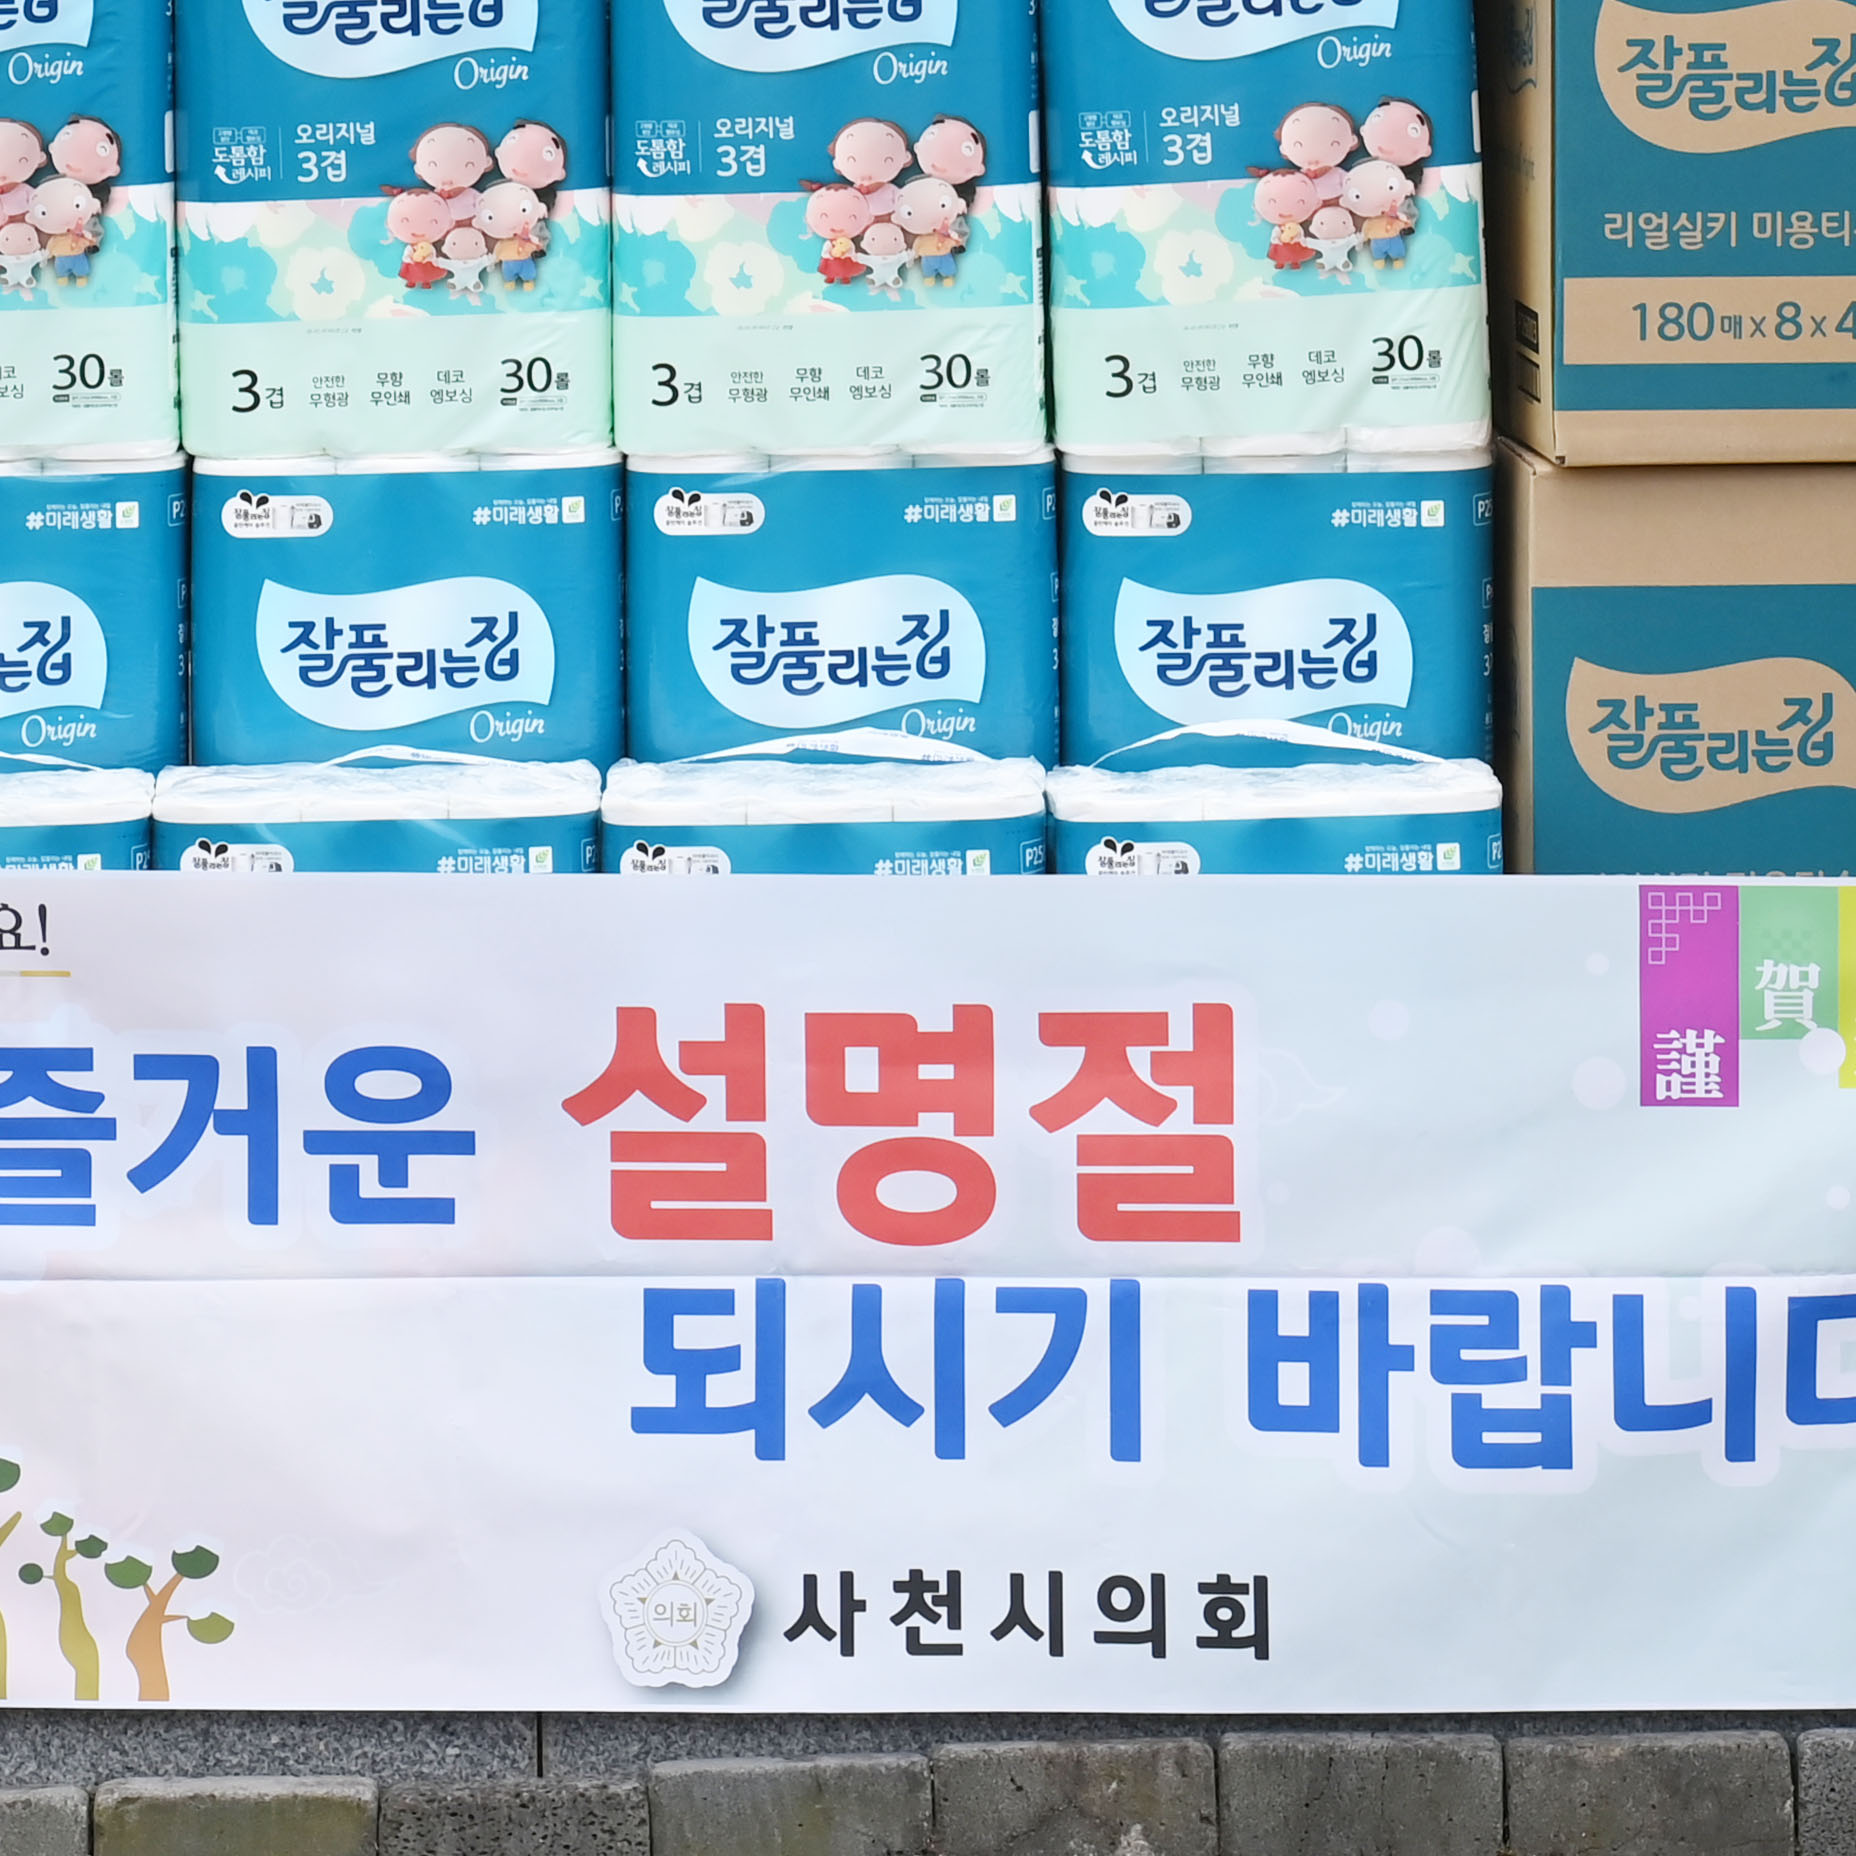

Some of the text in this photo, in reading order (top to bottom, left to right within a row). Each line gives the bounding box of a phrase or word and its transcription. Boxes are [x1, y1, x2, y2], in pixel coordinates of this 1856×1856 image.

[1318, 35, 1391, 70] Origin
[9, 51, 84, 87] Origin
[455, 56, 530, 92] Origin
[874, 51, 949, 87] Origin
[1160, 104, 1240, 128] 오리지널
[294, 121, 376, 146] 오리지널
[713, 115, 795, 140] 오리지널
[634, 139, 685, 159] 도톰함
[1079, 130, 1132, 151] 도톰함
[1162, 132, 1212, 165] 3겹
[213, 145, 266, 166] 도톰함
[297, 149, 347, 182] 3겹
[715, 143, 766, 176] 3겹
[1603, 211, 1738, 250] 리얼실키
[1183, 358, 1215, 372] 안전한
[1247, 352, 1274, 368] 무향
[1308, 349, 1337, 365] 데코
[313, 375, 344, 388] 안전한
[376, 371, 403, 387] 무향
[436, 369, 465, 385] 데코
[731, 370, 763, 384] 안전한
[795, 366, 822, 382] 무향
[856, 365, 885, 381] 데코
[1181, 374, 1221, 391] 무형광
[1241, 369, 1283, 388] 무인쇄
[1302, 368, 1345, 384] 엠보싱
[309, 391, 349, 408] 무형광
[370, 388, 411, 406] 무인쇄
[429, 387, 473, 404] 엠보싱
[728, 386, 768, 403] 무형광
[789, 383, 830, 401] 무인쇄
[849, 383, 893, 400] 엠보싱
[24, 508, 112, 529] #미래생활
[472, 504, 559, 525] #미래생활
[903, 502, 990, 523] #미래생활
[1331, 506, 1418, 527] #미래생활
[280, 610, 521, 698] 잘풀리는집
[711, 608, 952, 696] 잘풀리는집
[1138, 611, 1379, 699] 잘풀리는집
[22, 714, 97, 750] Origin
[470, 709, 545, 745] Origin
[903, 707, 976, 742] Origin
[1328, 712, 1403, 748] Origin
[1588, 693, 1834, 781] 잘풀리는집
[874, 855, 962, 874] #미래생활
[1344, 847, 1432, 872] #미래생활
[560, 1000, 1243, 1247] 설명절
[631, 1277, 1143, 1462] 되시기
[652, 1598, 700, 1630] 의회
[783, 1568, 1272, 1663] 사천시의회
